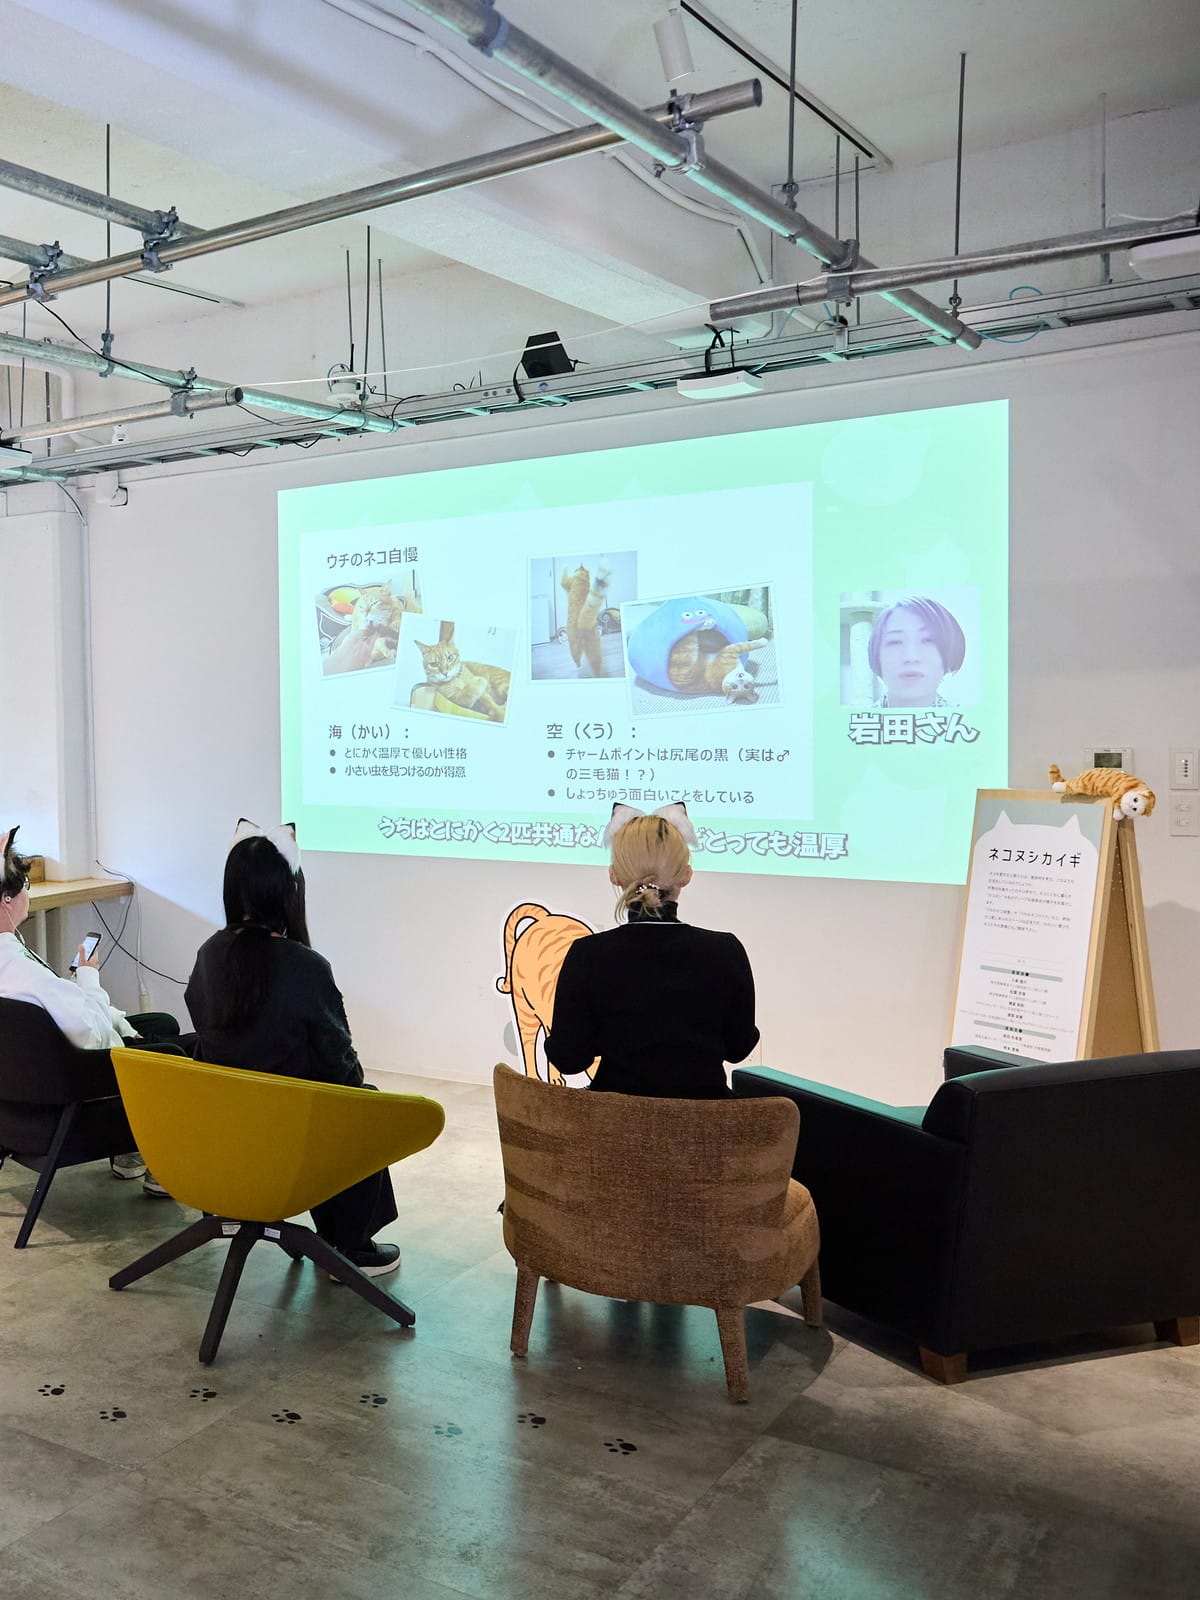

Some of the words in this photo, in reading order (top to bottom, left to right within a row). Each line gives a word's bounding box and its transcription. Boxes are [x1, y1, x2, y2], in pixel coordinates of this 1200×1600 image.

[327, 546, 419, 569] ウチのネコ自慢
[848, 711, 981, 745] 岩田さん
[344, 747, 468, 760] とにかく温厚で優しい性格
[344, 764, 467, 778] 小さい虫を見つけるのが得意
[566, 786, 755, 804] しょっちゅう面白いことをしている
[988, 847, 1081, 868] ネコヌシカイギ
